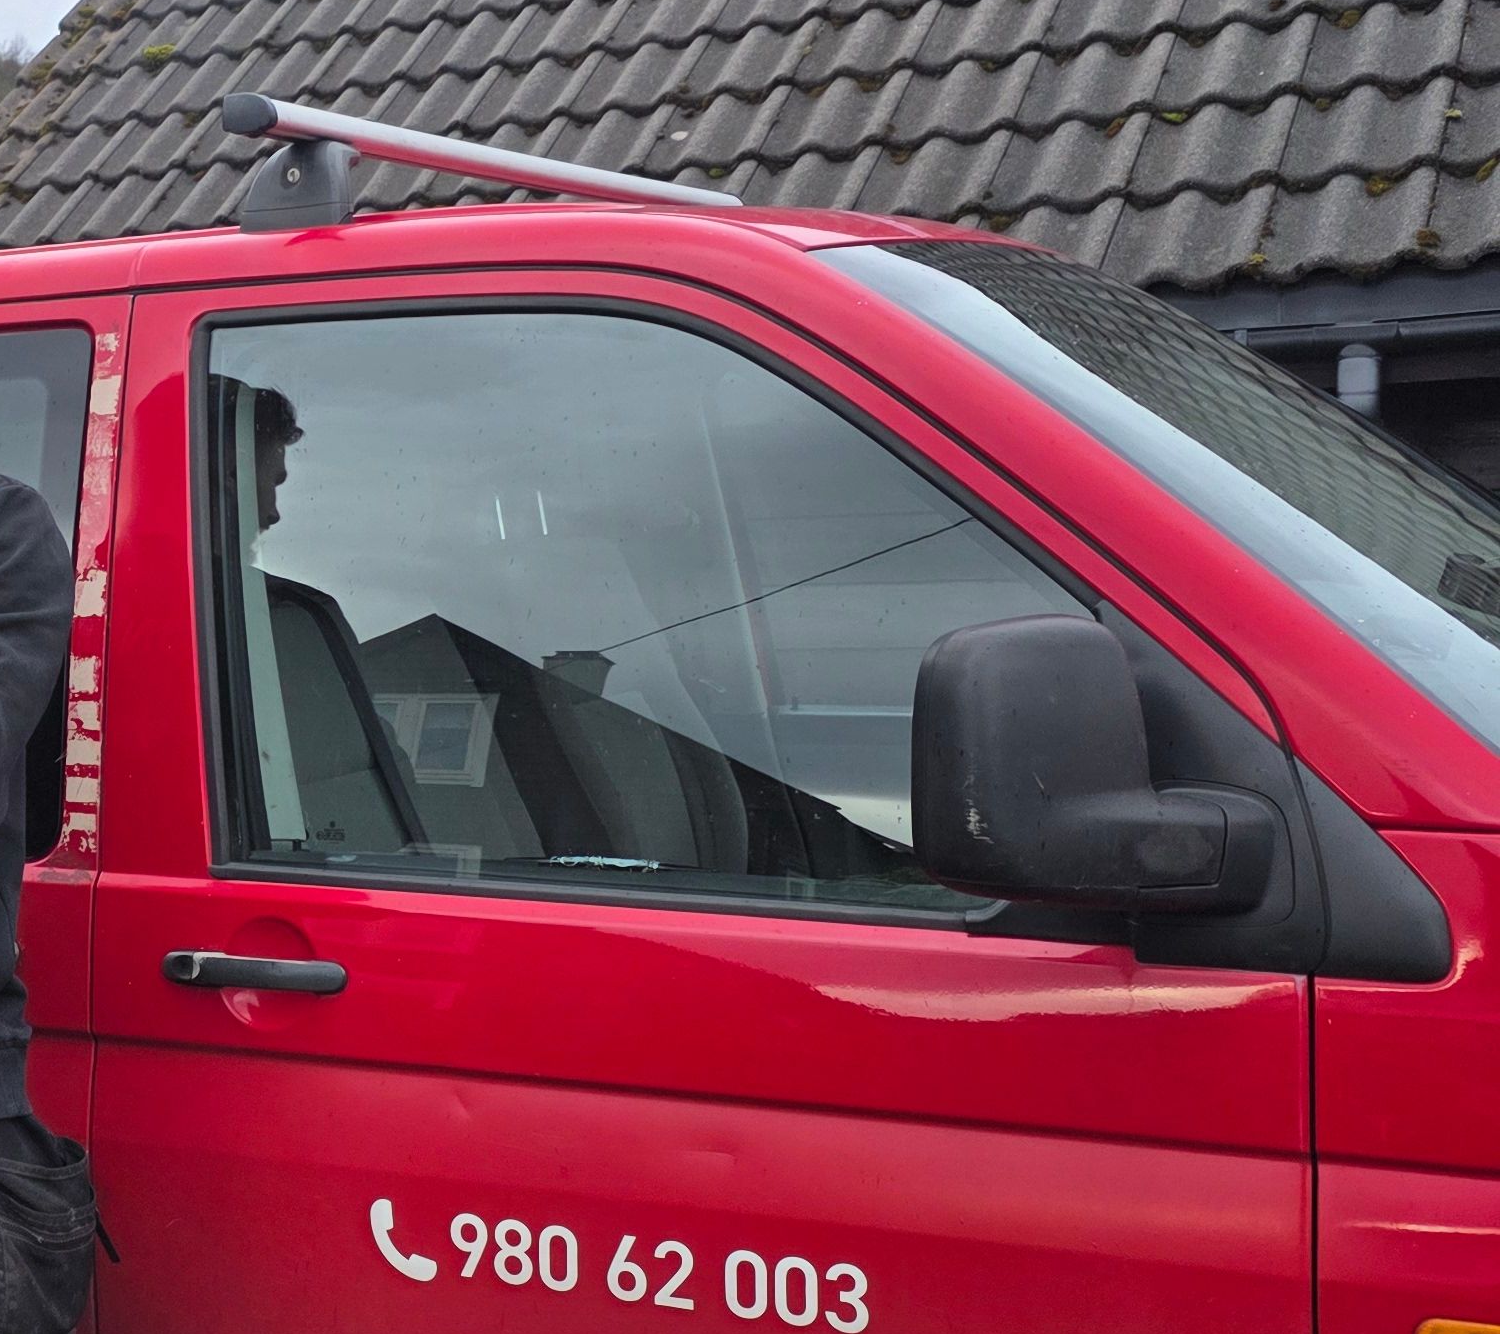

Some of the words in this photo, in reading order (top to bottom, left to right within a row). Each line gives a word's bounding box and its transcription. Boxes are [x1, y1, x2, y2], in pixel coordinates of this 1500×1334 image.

[450, 1213, 579, 1293] 980
[607, 1234, 695, 1311] 62
[725, 1250, 870, 1334] 003
